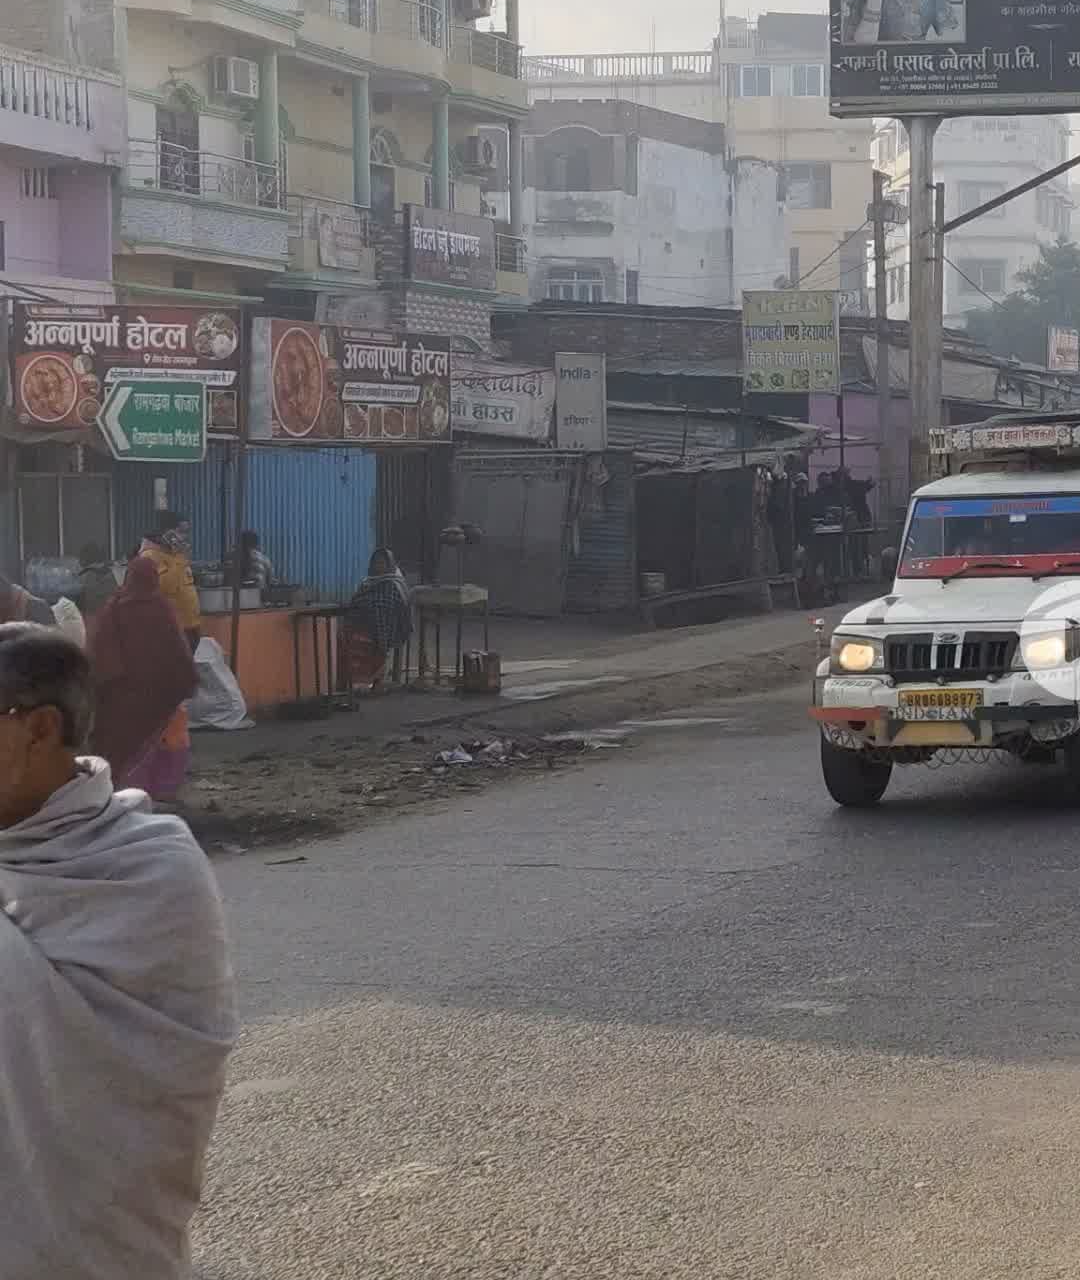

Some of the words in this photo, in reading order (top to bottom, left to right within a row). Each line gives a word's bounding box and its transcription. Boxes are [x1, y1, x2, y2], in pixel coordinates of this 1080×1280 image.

[23, 315, 120, 356] अन्नपूर्णा
[126, 315, 188, 350] होटल
[342, 341, 407, 380] अन्नपूर्णा
[411, 342, 449, 377] होटल
